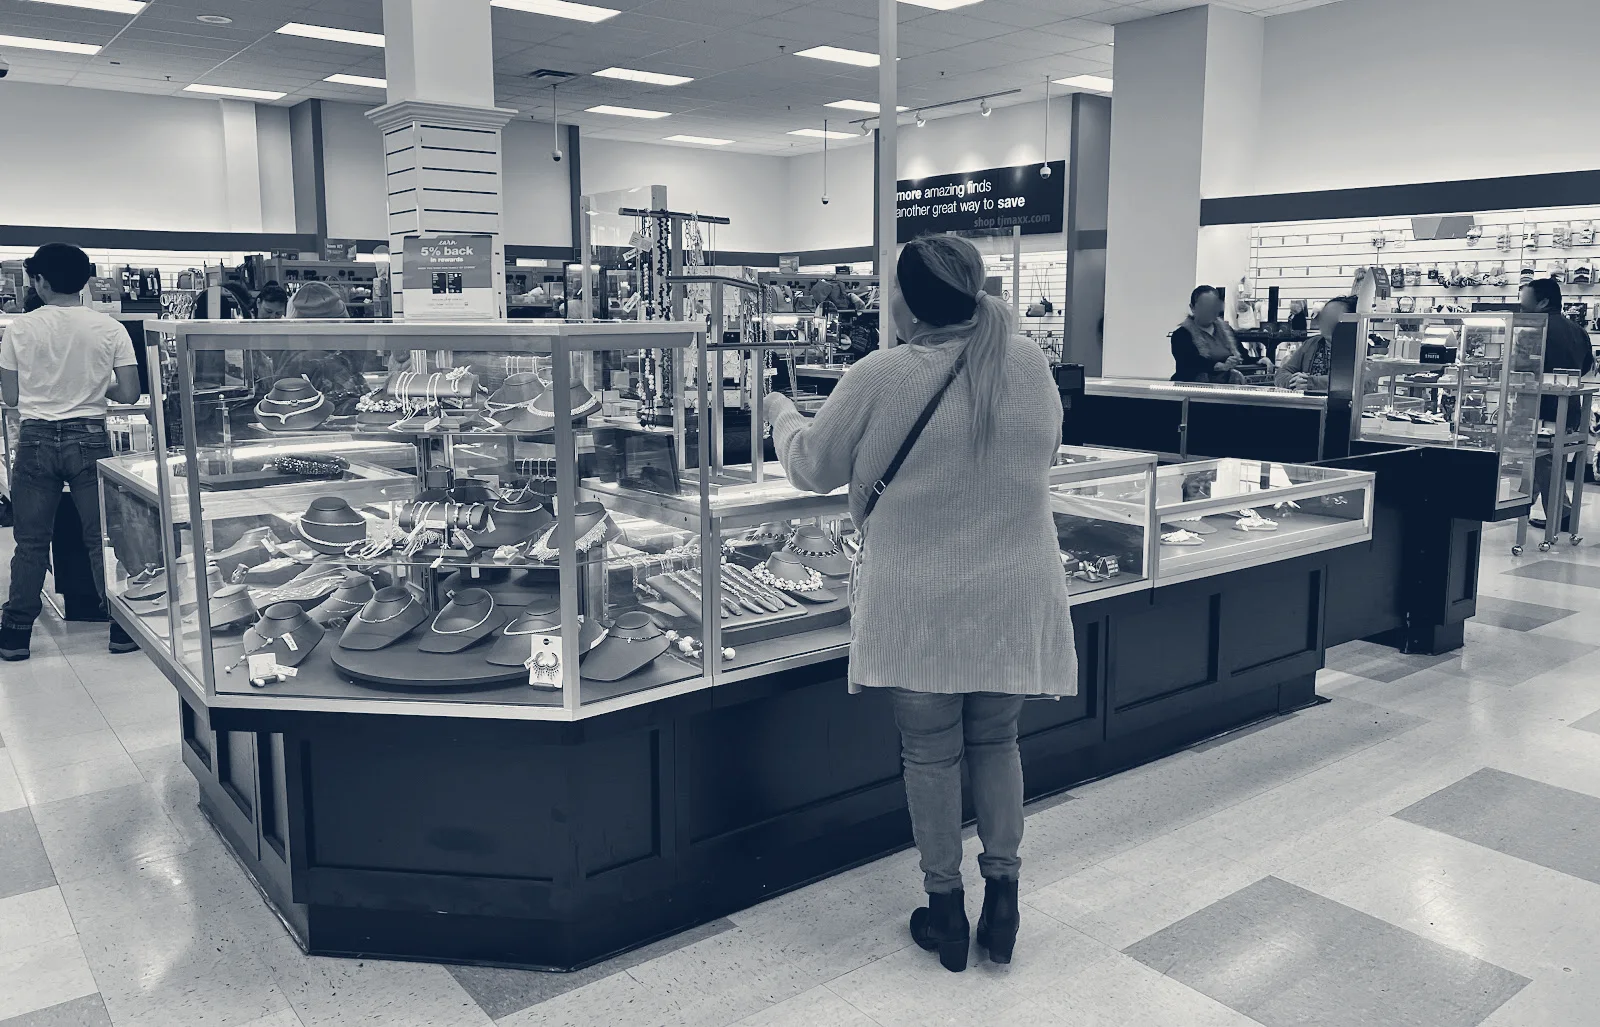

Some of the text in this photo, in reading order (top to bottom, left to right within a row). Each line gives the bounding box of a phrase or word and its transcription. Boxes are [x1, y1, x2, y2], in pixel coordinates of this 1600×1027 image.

[896, 179, 991, 201] more amazing finds
[896, 196, 1025, 218] another great way to save
[974, 213, 1050, 228] shop tjmaxx.com
[420, 246, 474, 257] 5% back
